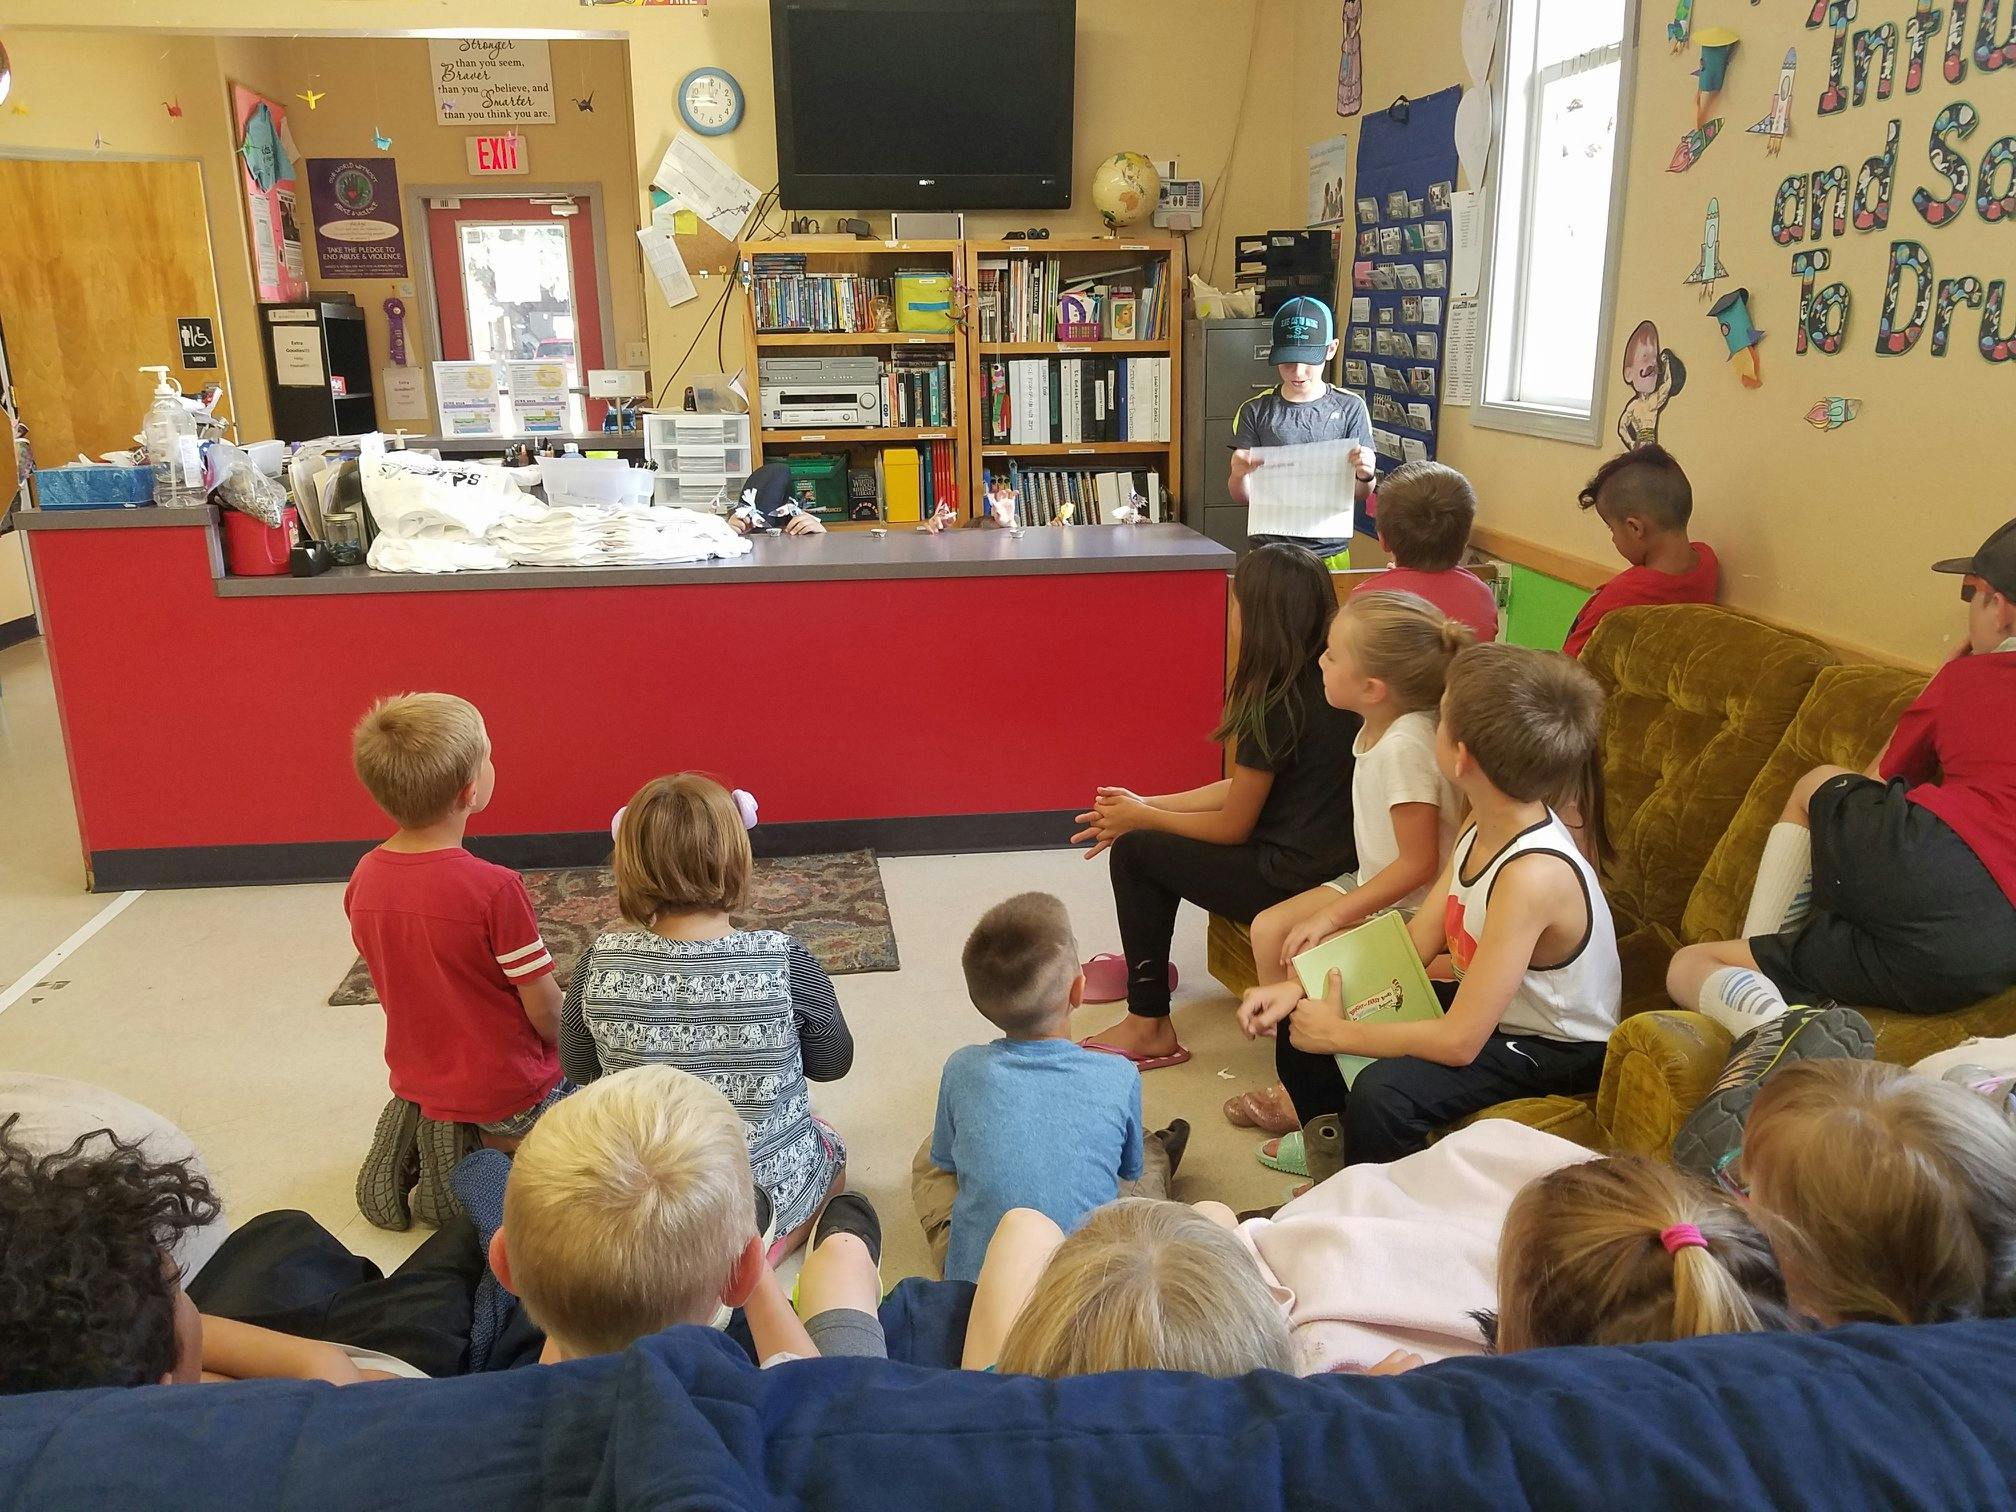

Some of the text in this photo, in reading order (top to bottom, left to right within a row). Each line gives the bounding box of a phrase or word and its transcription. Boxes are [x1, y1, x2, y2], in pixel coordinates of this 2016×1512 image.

[459, 39, 516, 60] Stronger
[440, 62, 491, 82] Braver
[455, 59, 477, 67] than
[480, 60, 496, 70] you
[438, 83, 549, 96] than you believe, and
[481, 89, 536, 108] Smarter
[444, 109, 551, 121] than you think you are.
[337, 162, 354, 174] WORLD
[355, 164, 379, 183] WITHOUT
[1771, 119, 1900, 247] and
[355, 201, 379, 217] VIOLENCE
[1791, 248, 1853, 356] To
